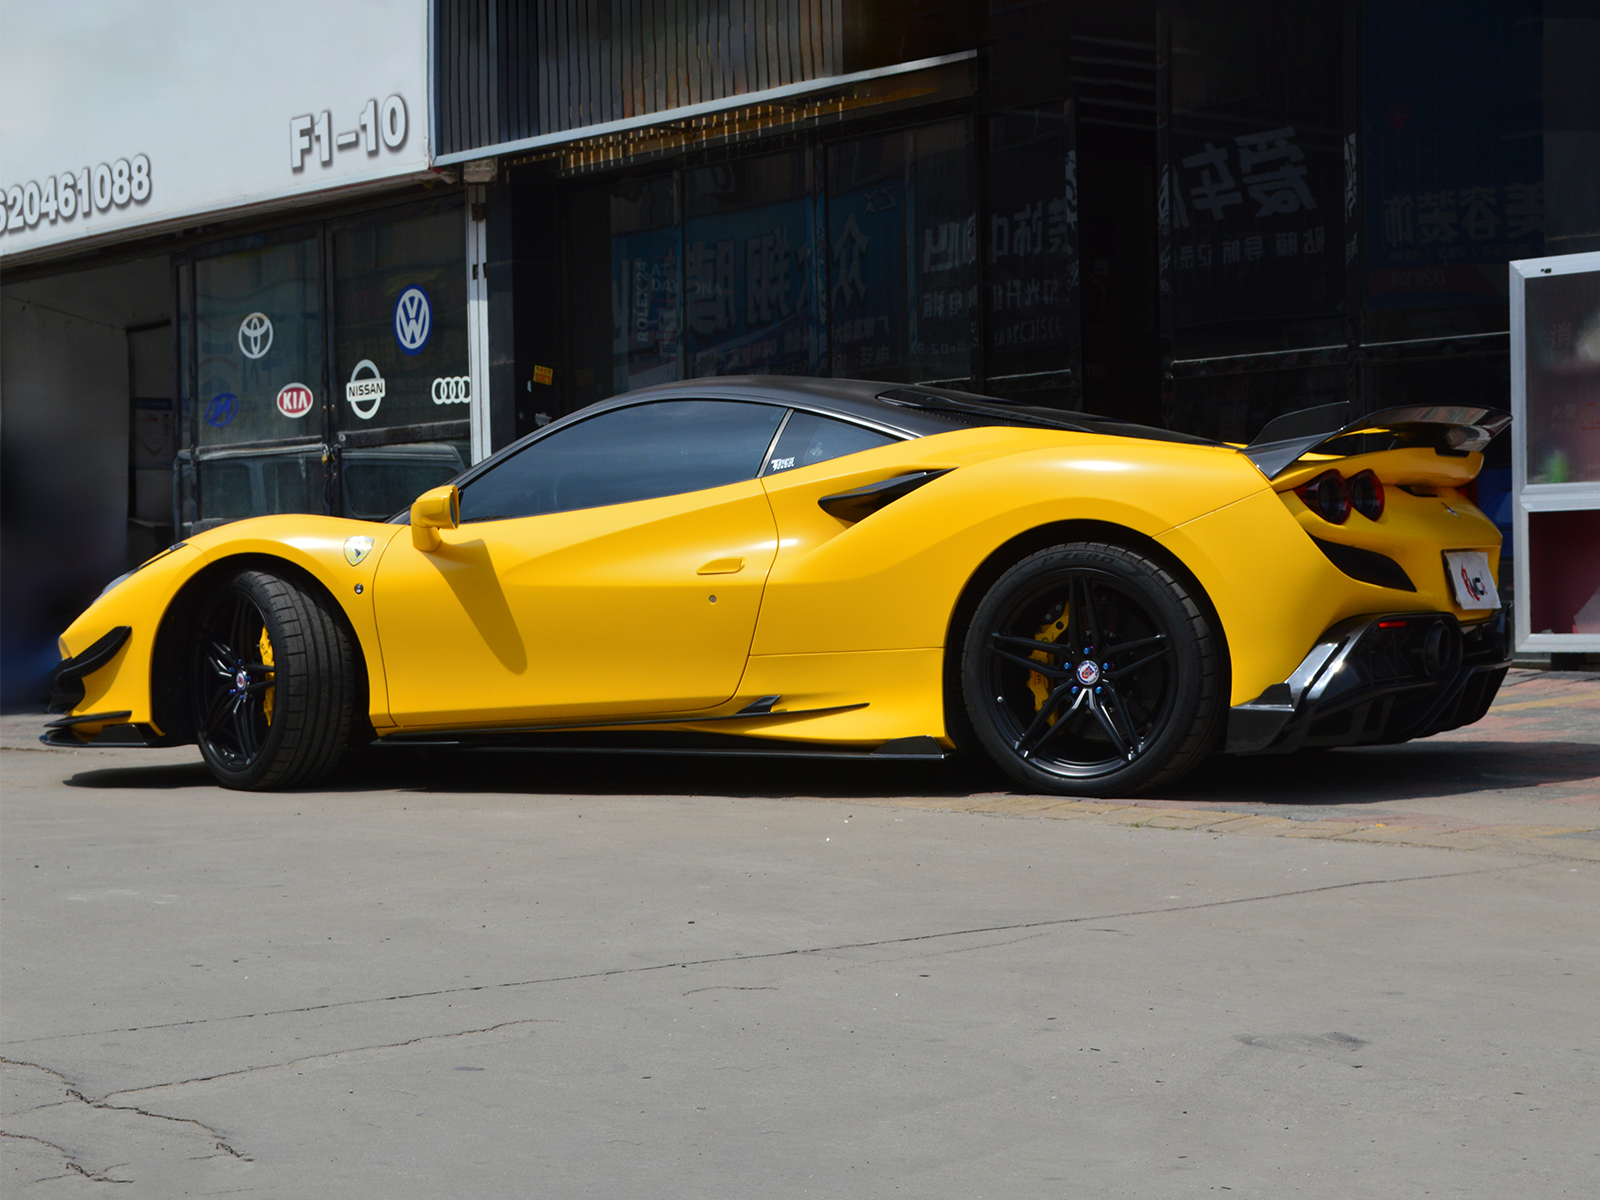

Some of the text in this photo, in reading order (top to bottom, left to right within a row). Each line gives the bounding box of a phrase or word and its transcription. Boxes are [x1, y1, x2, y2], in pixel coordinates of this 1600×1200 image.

[290, 94, 408, 173] F1-10
[283, 389, 308, 411] KIA
[348, 381, 384, 397] NISSAN
